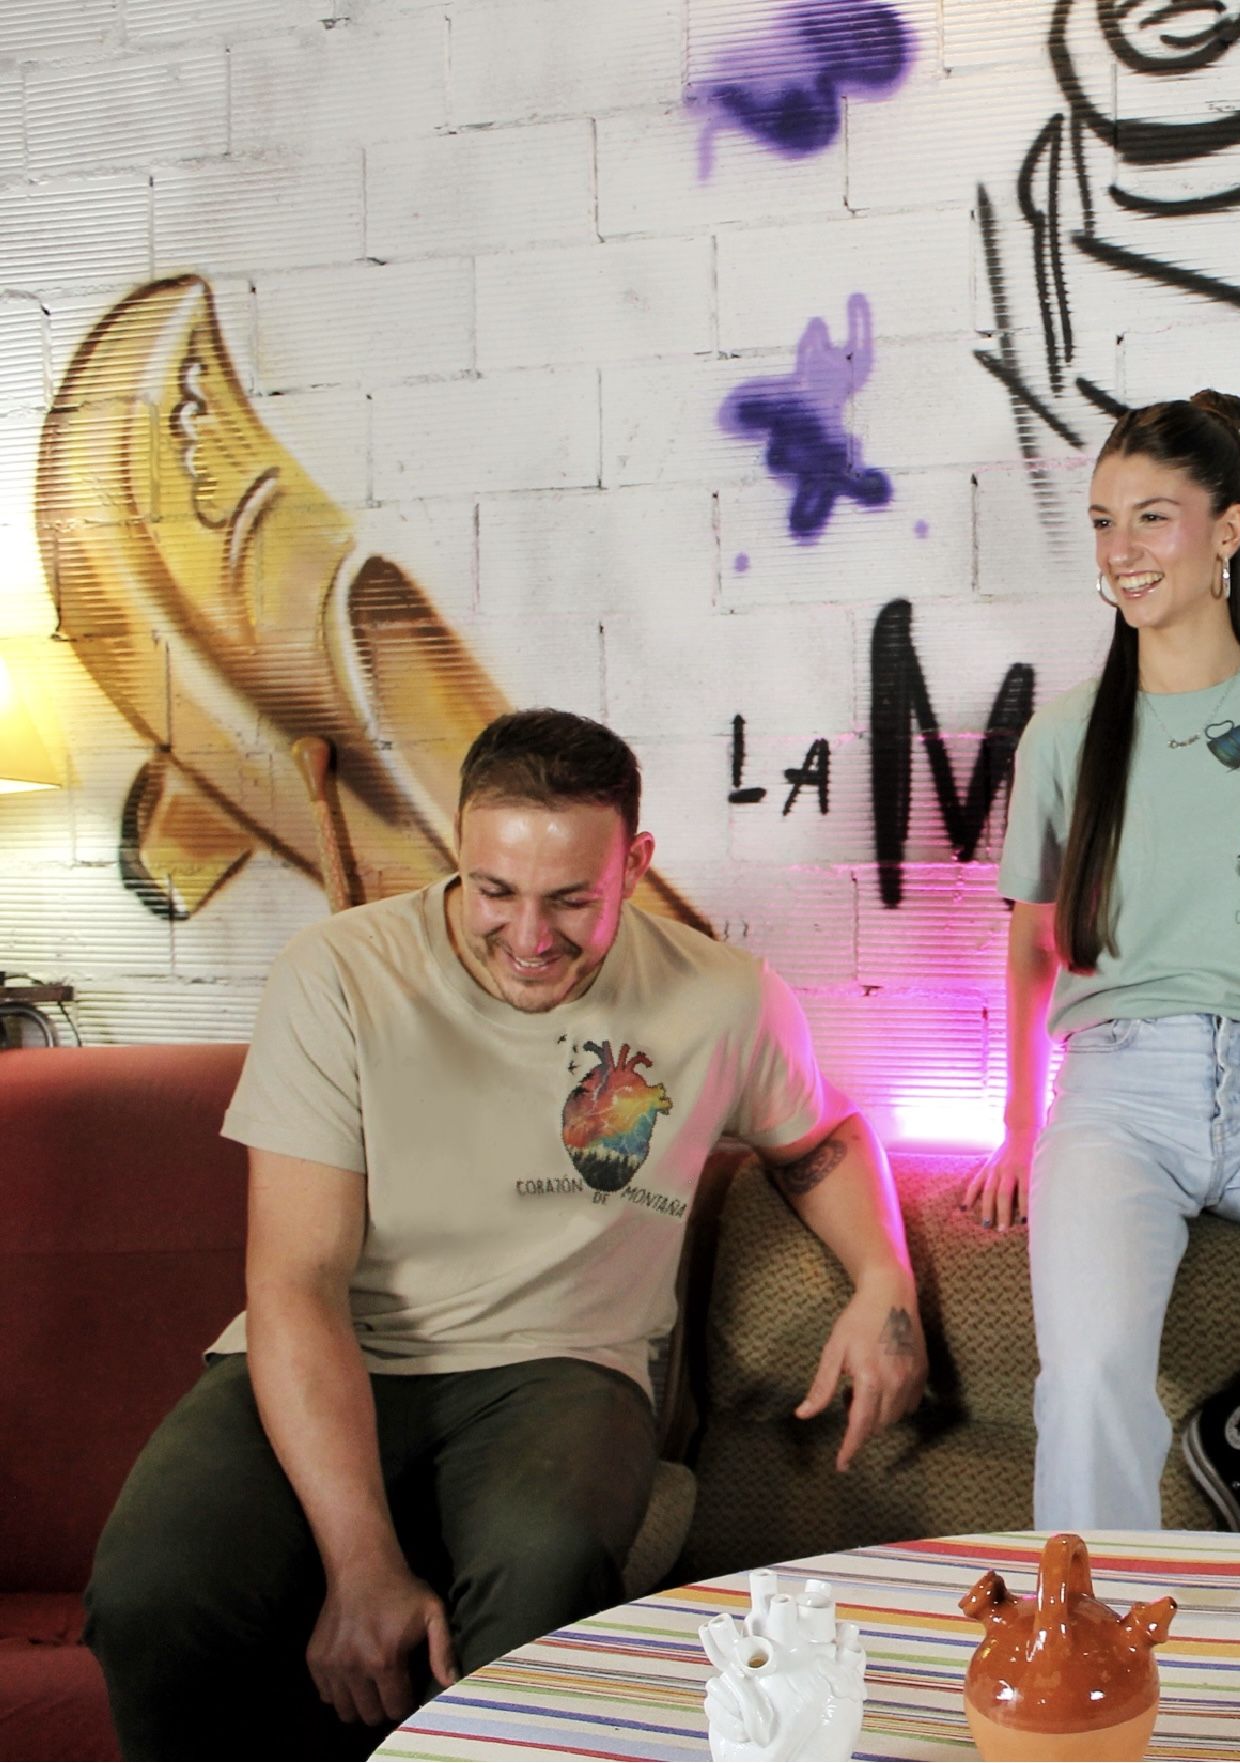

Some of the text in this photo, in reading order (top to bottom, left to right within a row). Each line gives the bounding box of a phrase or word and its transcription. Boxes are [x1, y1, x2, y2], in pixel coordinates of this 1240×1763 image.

[727, 713, 831, 817] LA
[516, 1174, 688, 1219] CORAZÓN DE MONTAÑA
